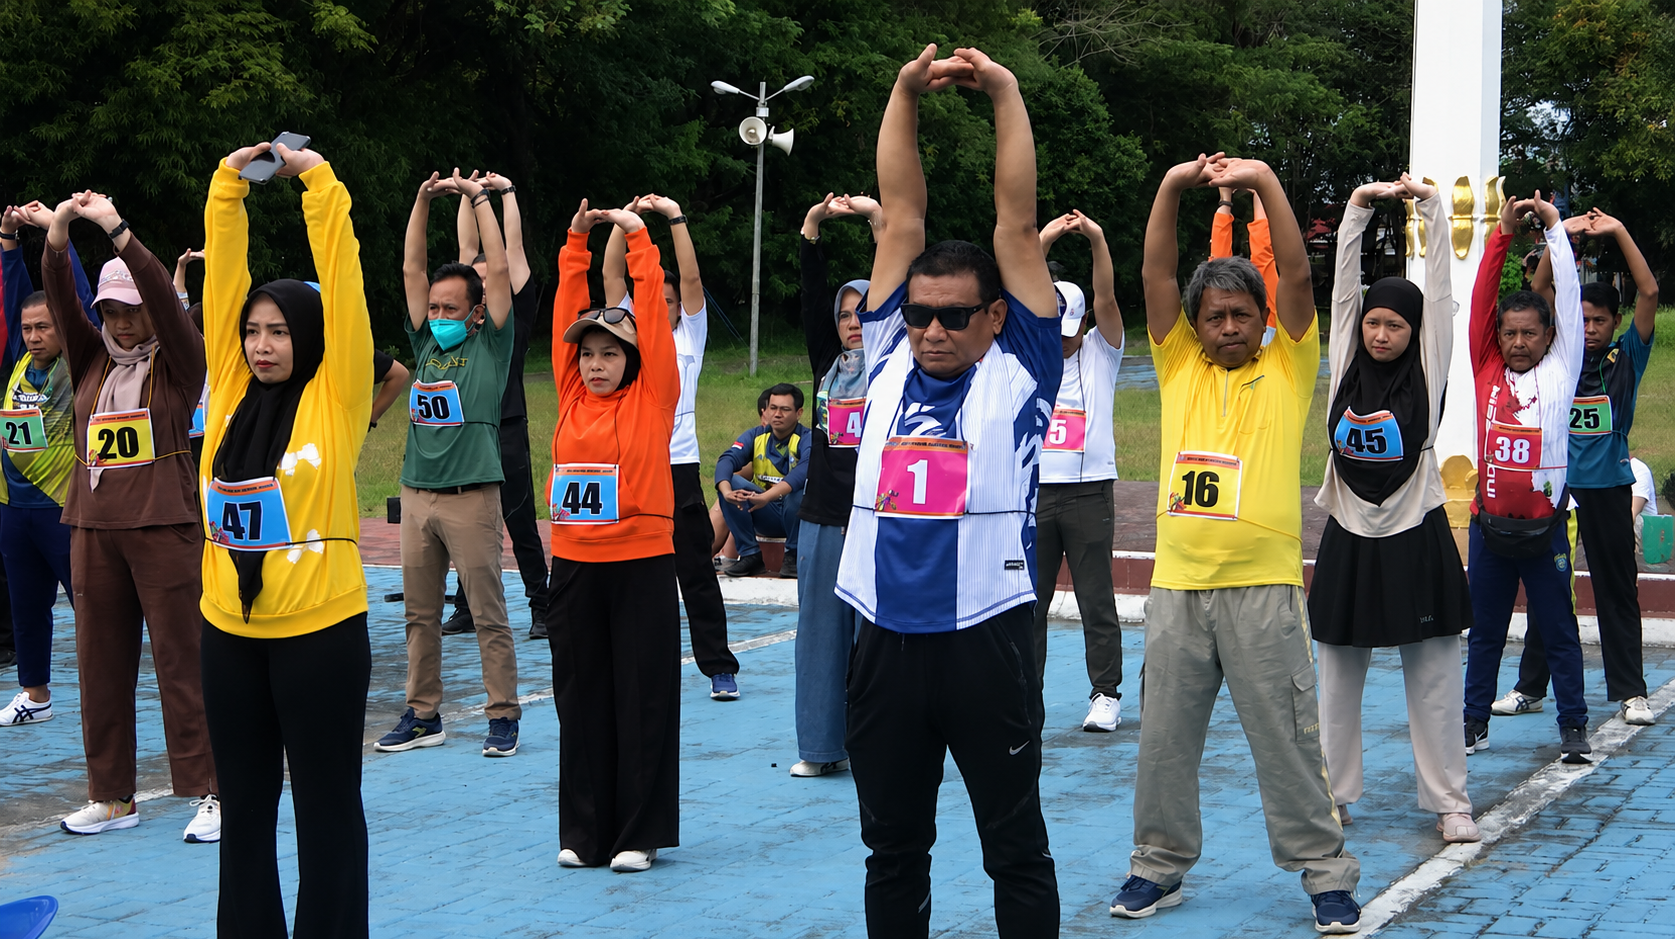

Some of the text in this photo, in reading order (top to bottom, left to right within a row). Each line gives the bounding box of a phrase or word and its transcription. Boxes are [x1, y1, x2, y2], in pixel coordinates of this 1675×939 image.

[417, 394, 450, 419] 50
[1570, 408, 1600, 429] 25
[5, 421, 32, 445] 21
[846, 412, 861, 437] 4
[1049, 419, 1067, 444] 5
[98, 426, 139, 460] 20
[1346, 427, 1387, 454] 45
[1494, 436, 1530, 464] 38
[906, 459, 928, 504] 1
[1181, 470, 1219, 507] 16
[562, 482, 602, 514] 44
[221, 500, 263, 541] 47
